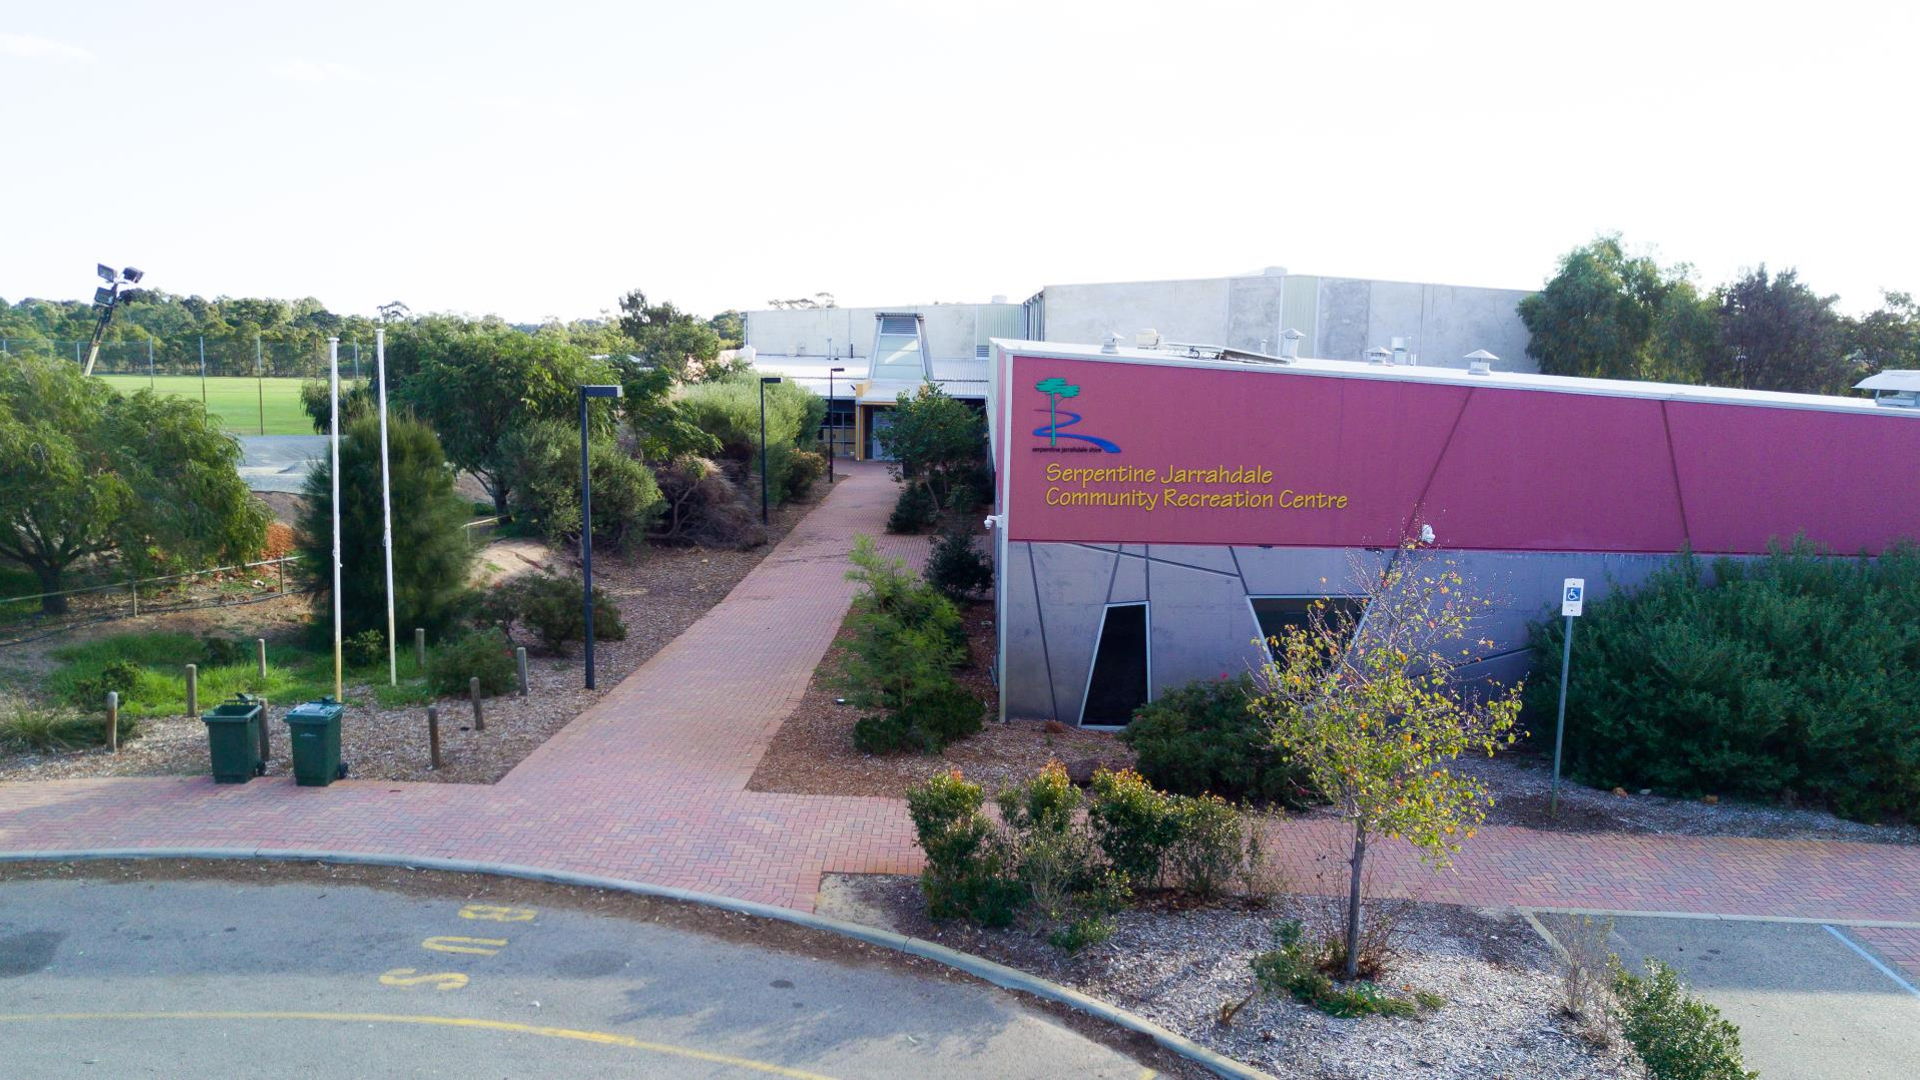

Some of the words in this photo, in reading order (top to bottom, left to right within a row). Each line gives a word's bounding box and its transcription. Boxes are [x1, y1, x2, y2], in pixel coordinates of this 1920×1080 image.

[1046, 464, 1157, 487] Serpentine
[1160, 465, 1273, 484] Jarrahdale
[1045, 487, 1158, 511] Community
[1163, 488, 1274, 508] Recreation
[1278, 490, 1348, 509] Centre
[378, 904, 539, 990] BUS
